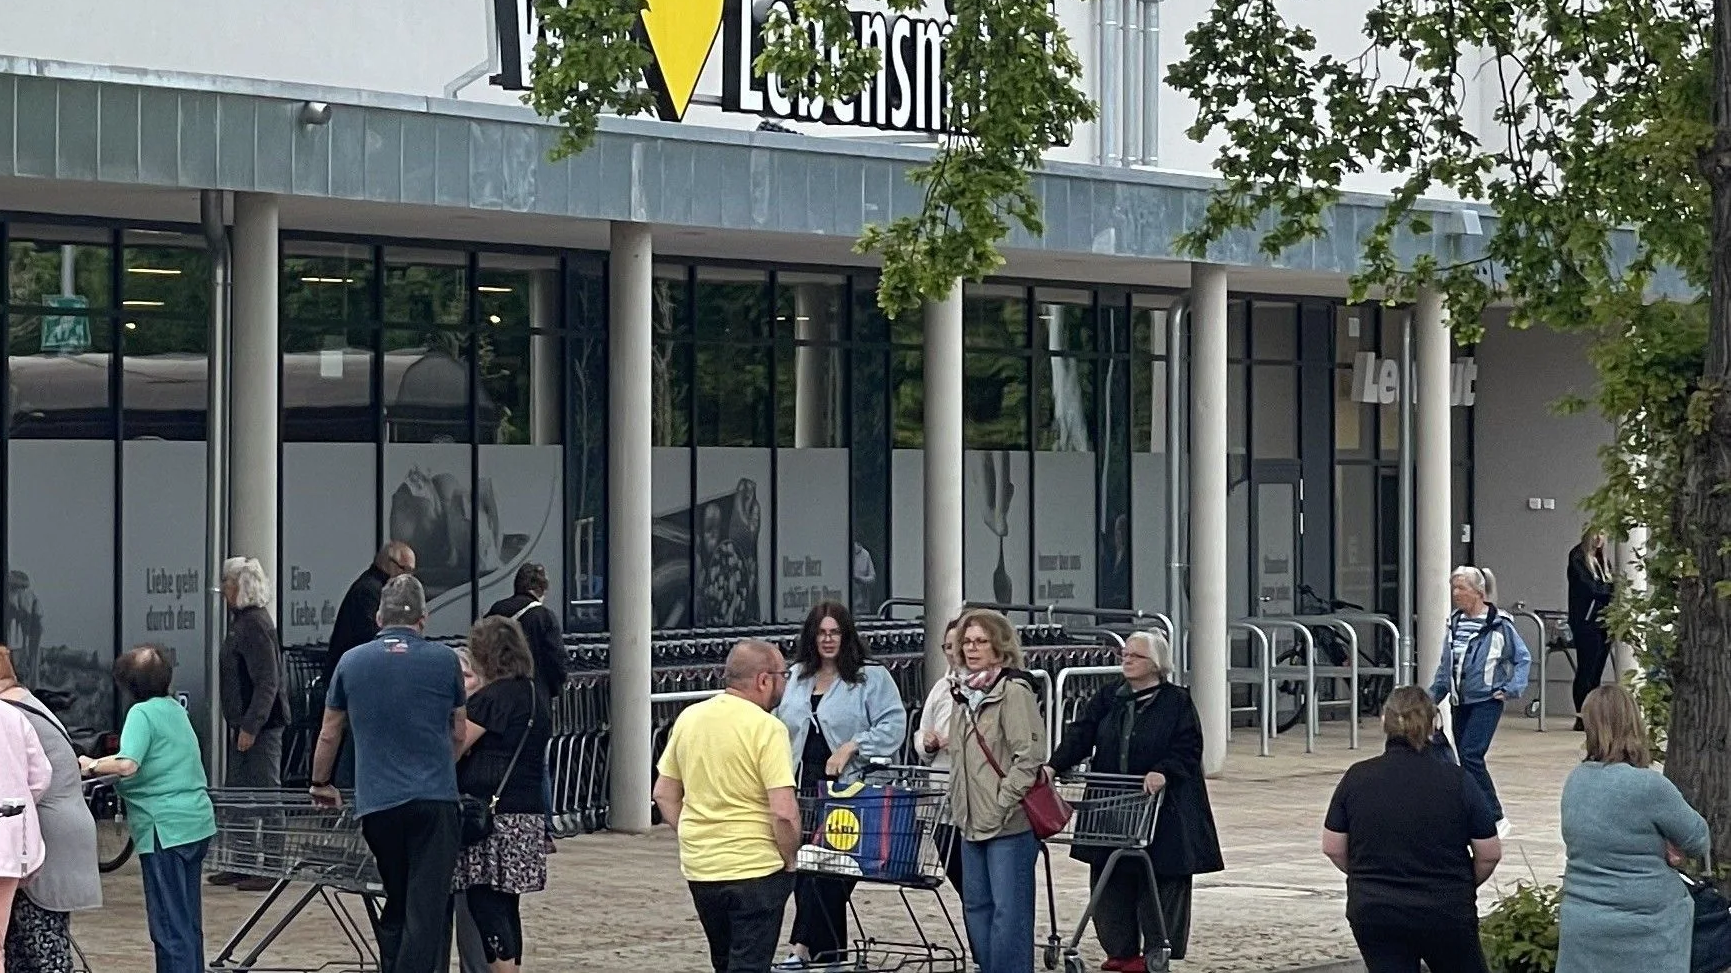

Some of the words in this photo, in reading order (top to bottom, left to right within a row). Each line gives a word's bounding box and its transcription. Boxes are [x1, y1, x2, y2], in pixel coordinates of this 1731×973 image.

[146, 567, 173, 594] Liebe
[175, 569, 199, 600] geht
[291, 566, 311, 590] Eine
[146, 605, 175, 631] durch
[177, 605, 195, 630] den
